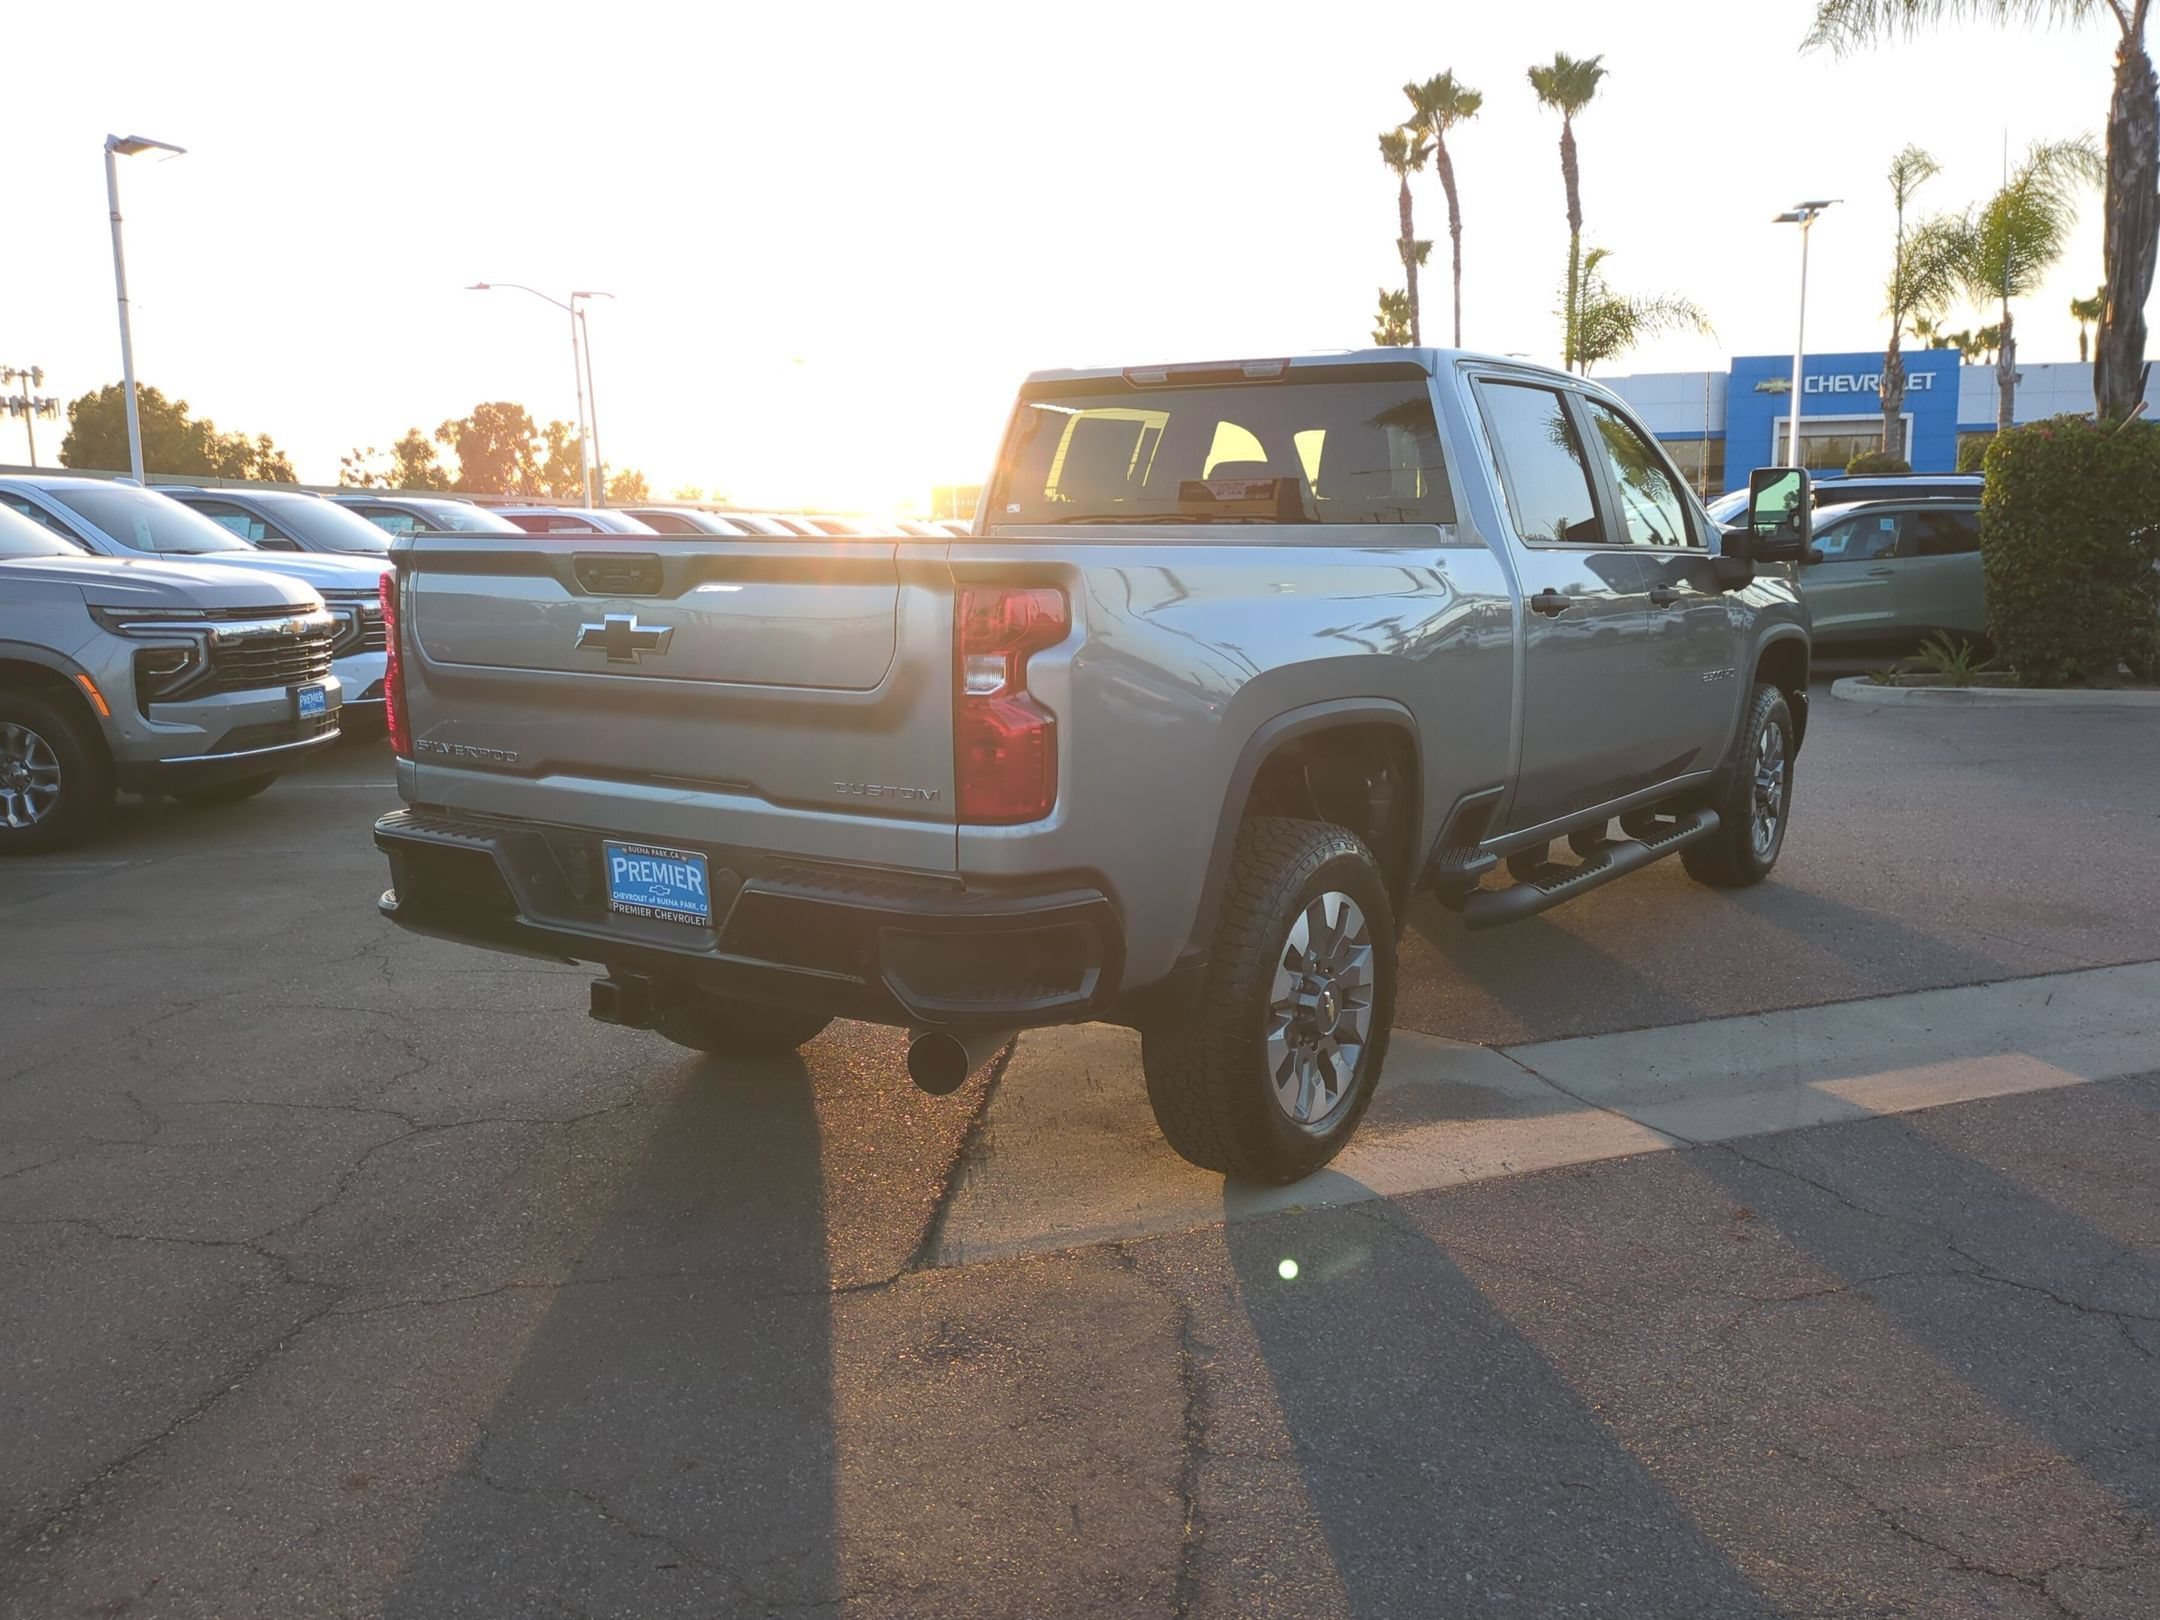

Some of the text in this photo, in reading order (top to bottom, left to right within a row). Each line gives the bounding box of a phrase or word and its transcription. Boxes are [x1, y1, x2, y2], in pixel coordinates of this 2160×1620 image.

[1804, 371, 1937, 394] CHEVRET
[833, 781, 940, 801] CUSTOM
[628, 846, 650, 855] BUENA
[612, 857, 704, 896] PREMIER
[613, 891, 647, 901] CHEVROLET
[657, 897, 678, 906] BUENA
[613, 902, 706, 926] PREMIER CHEVROLET
